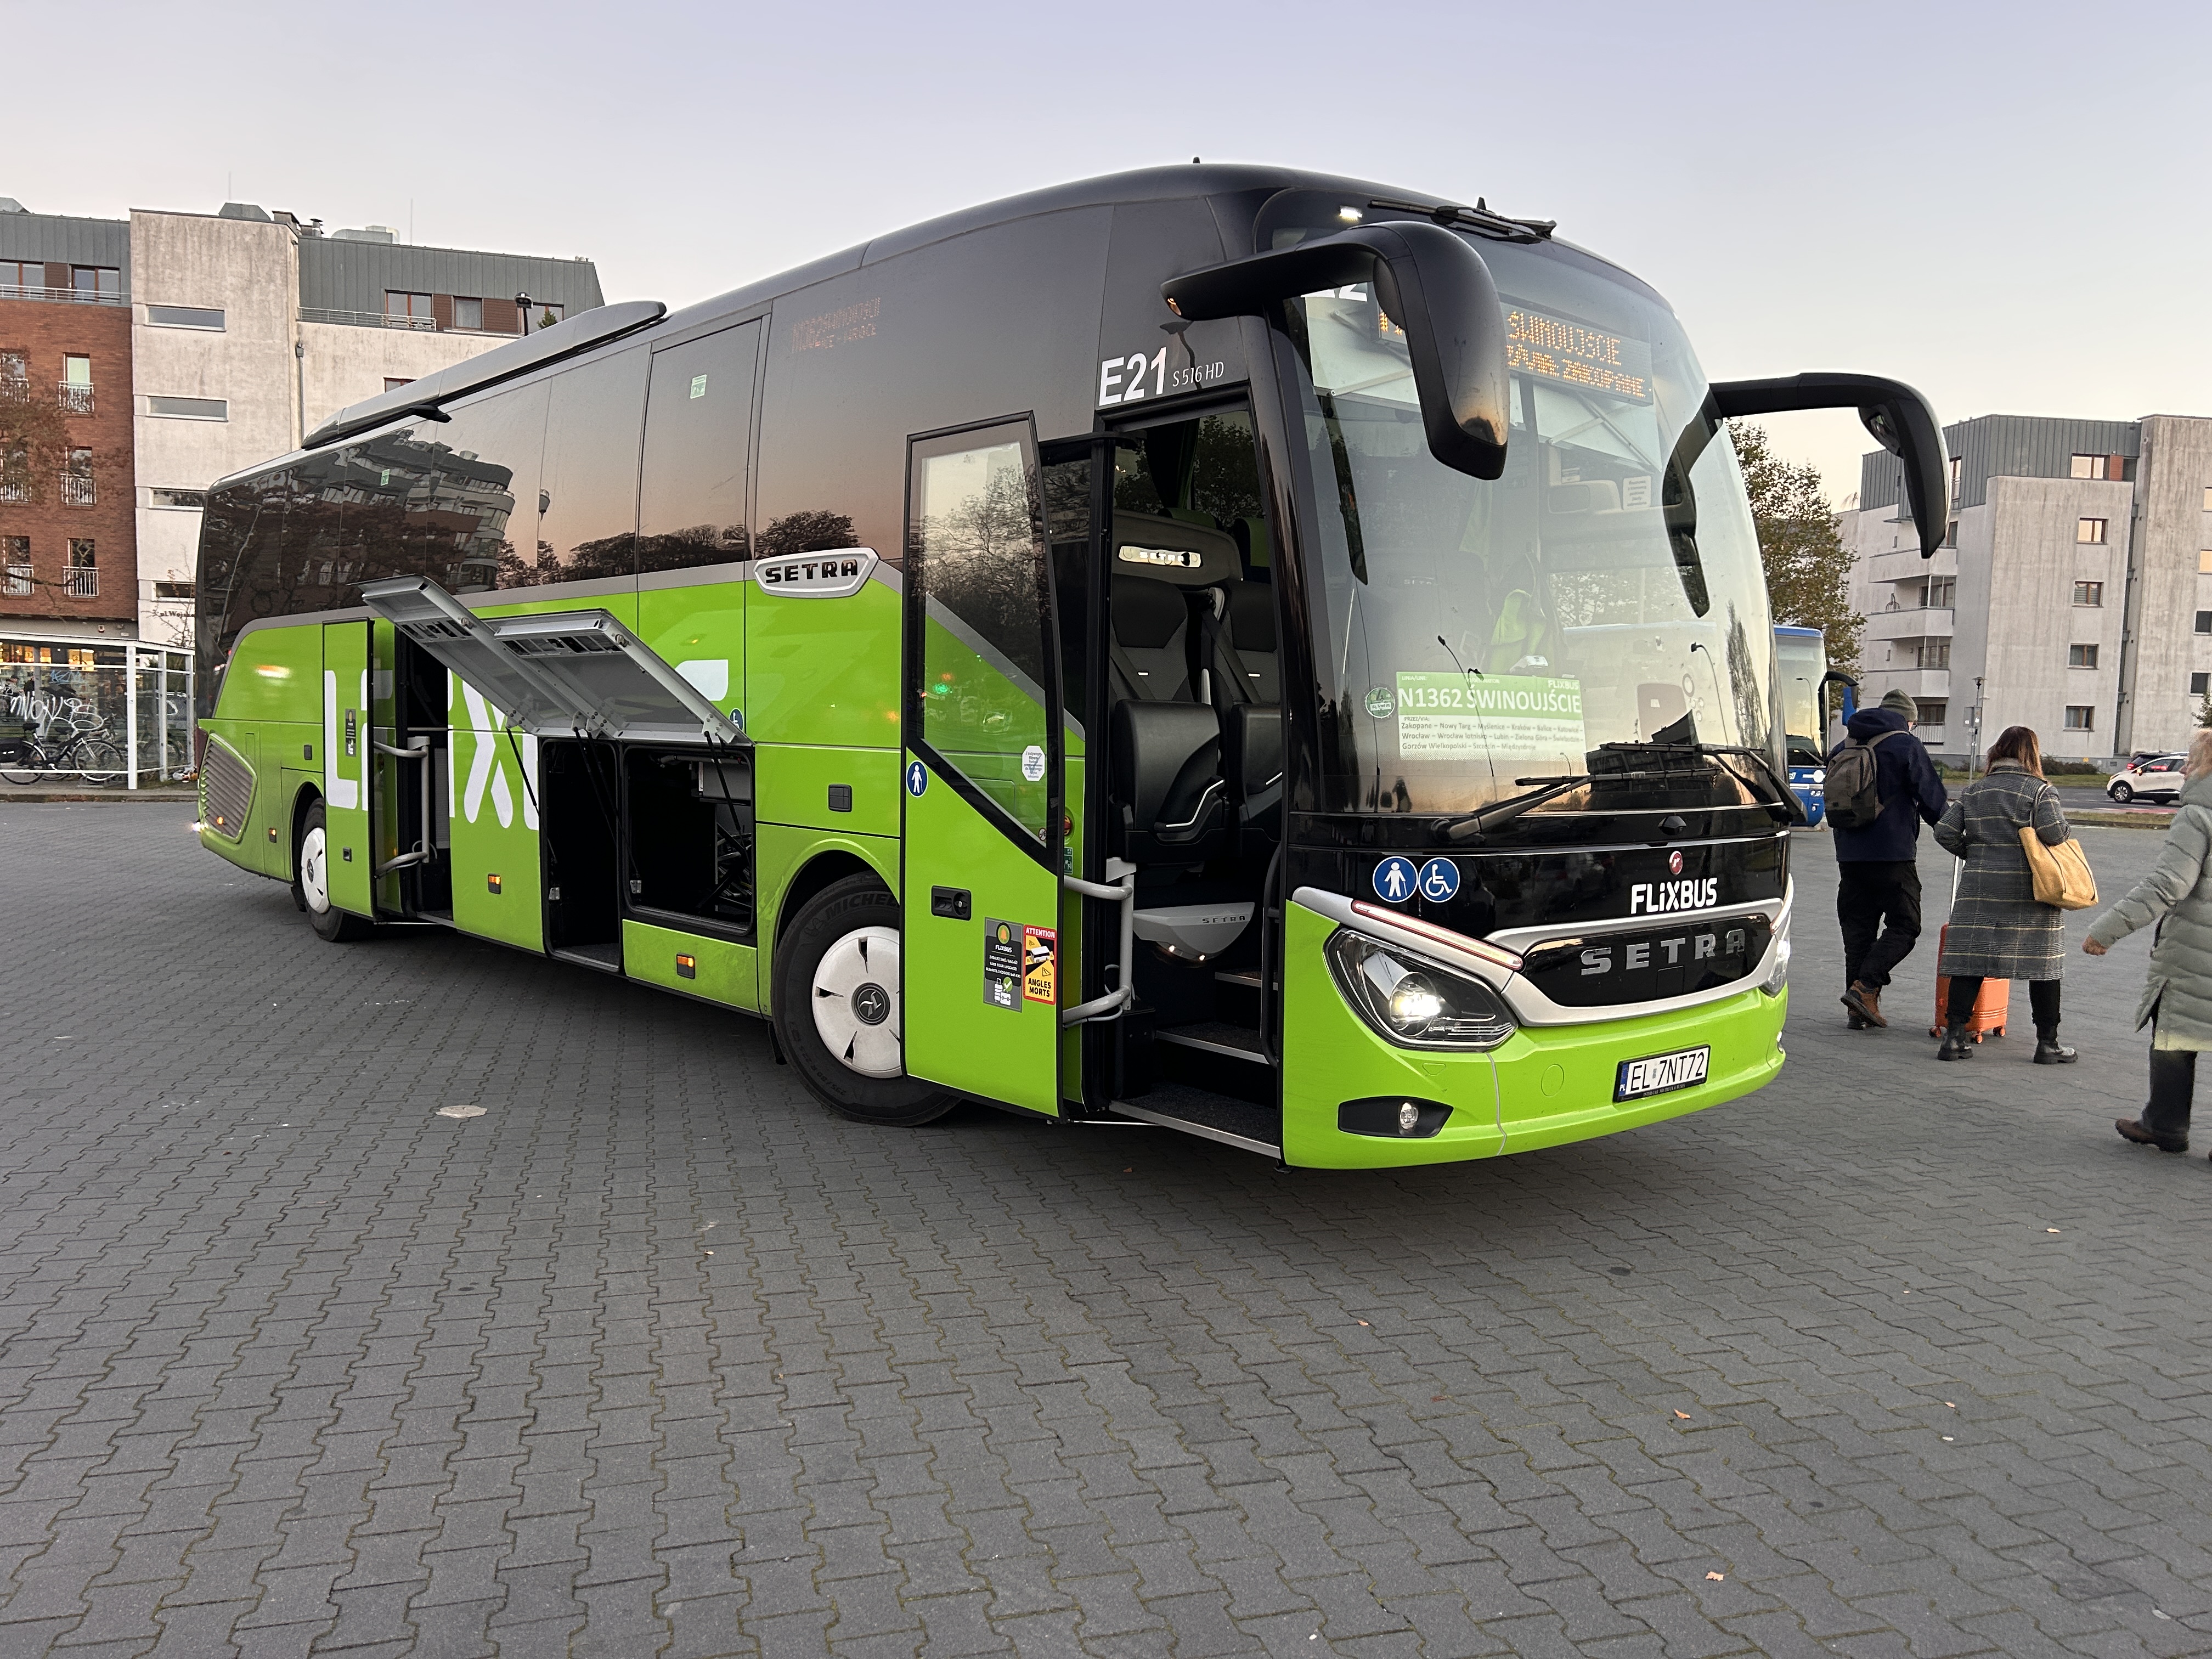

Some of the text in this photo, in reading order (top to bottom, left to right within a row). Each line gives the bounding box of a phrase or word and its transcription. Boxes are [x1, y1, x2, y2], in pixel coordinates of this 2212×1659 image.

[1098, 346, 1167, 407] E21
[1172, 361, 1224, 387] S 516 HD
[765, 558, 858, 584] SETRA
[1398, 684, 1582, 713] N1362 ŚWINOUJŚCIE
[1428, 742, 1467, 751] Wielkopolski
[1202, 915, 1245, 924] SETRA
[1025, 927, 1056, 939] ATTENTION
[1580, 929, 1746, 977] SETRA
[1028, 978, 1052, 989] ANGLES
[1029, 986, 1050, 997] MORTS
[1620, 1052, 1705, 1092] PL EL 7NT72
